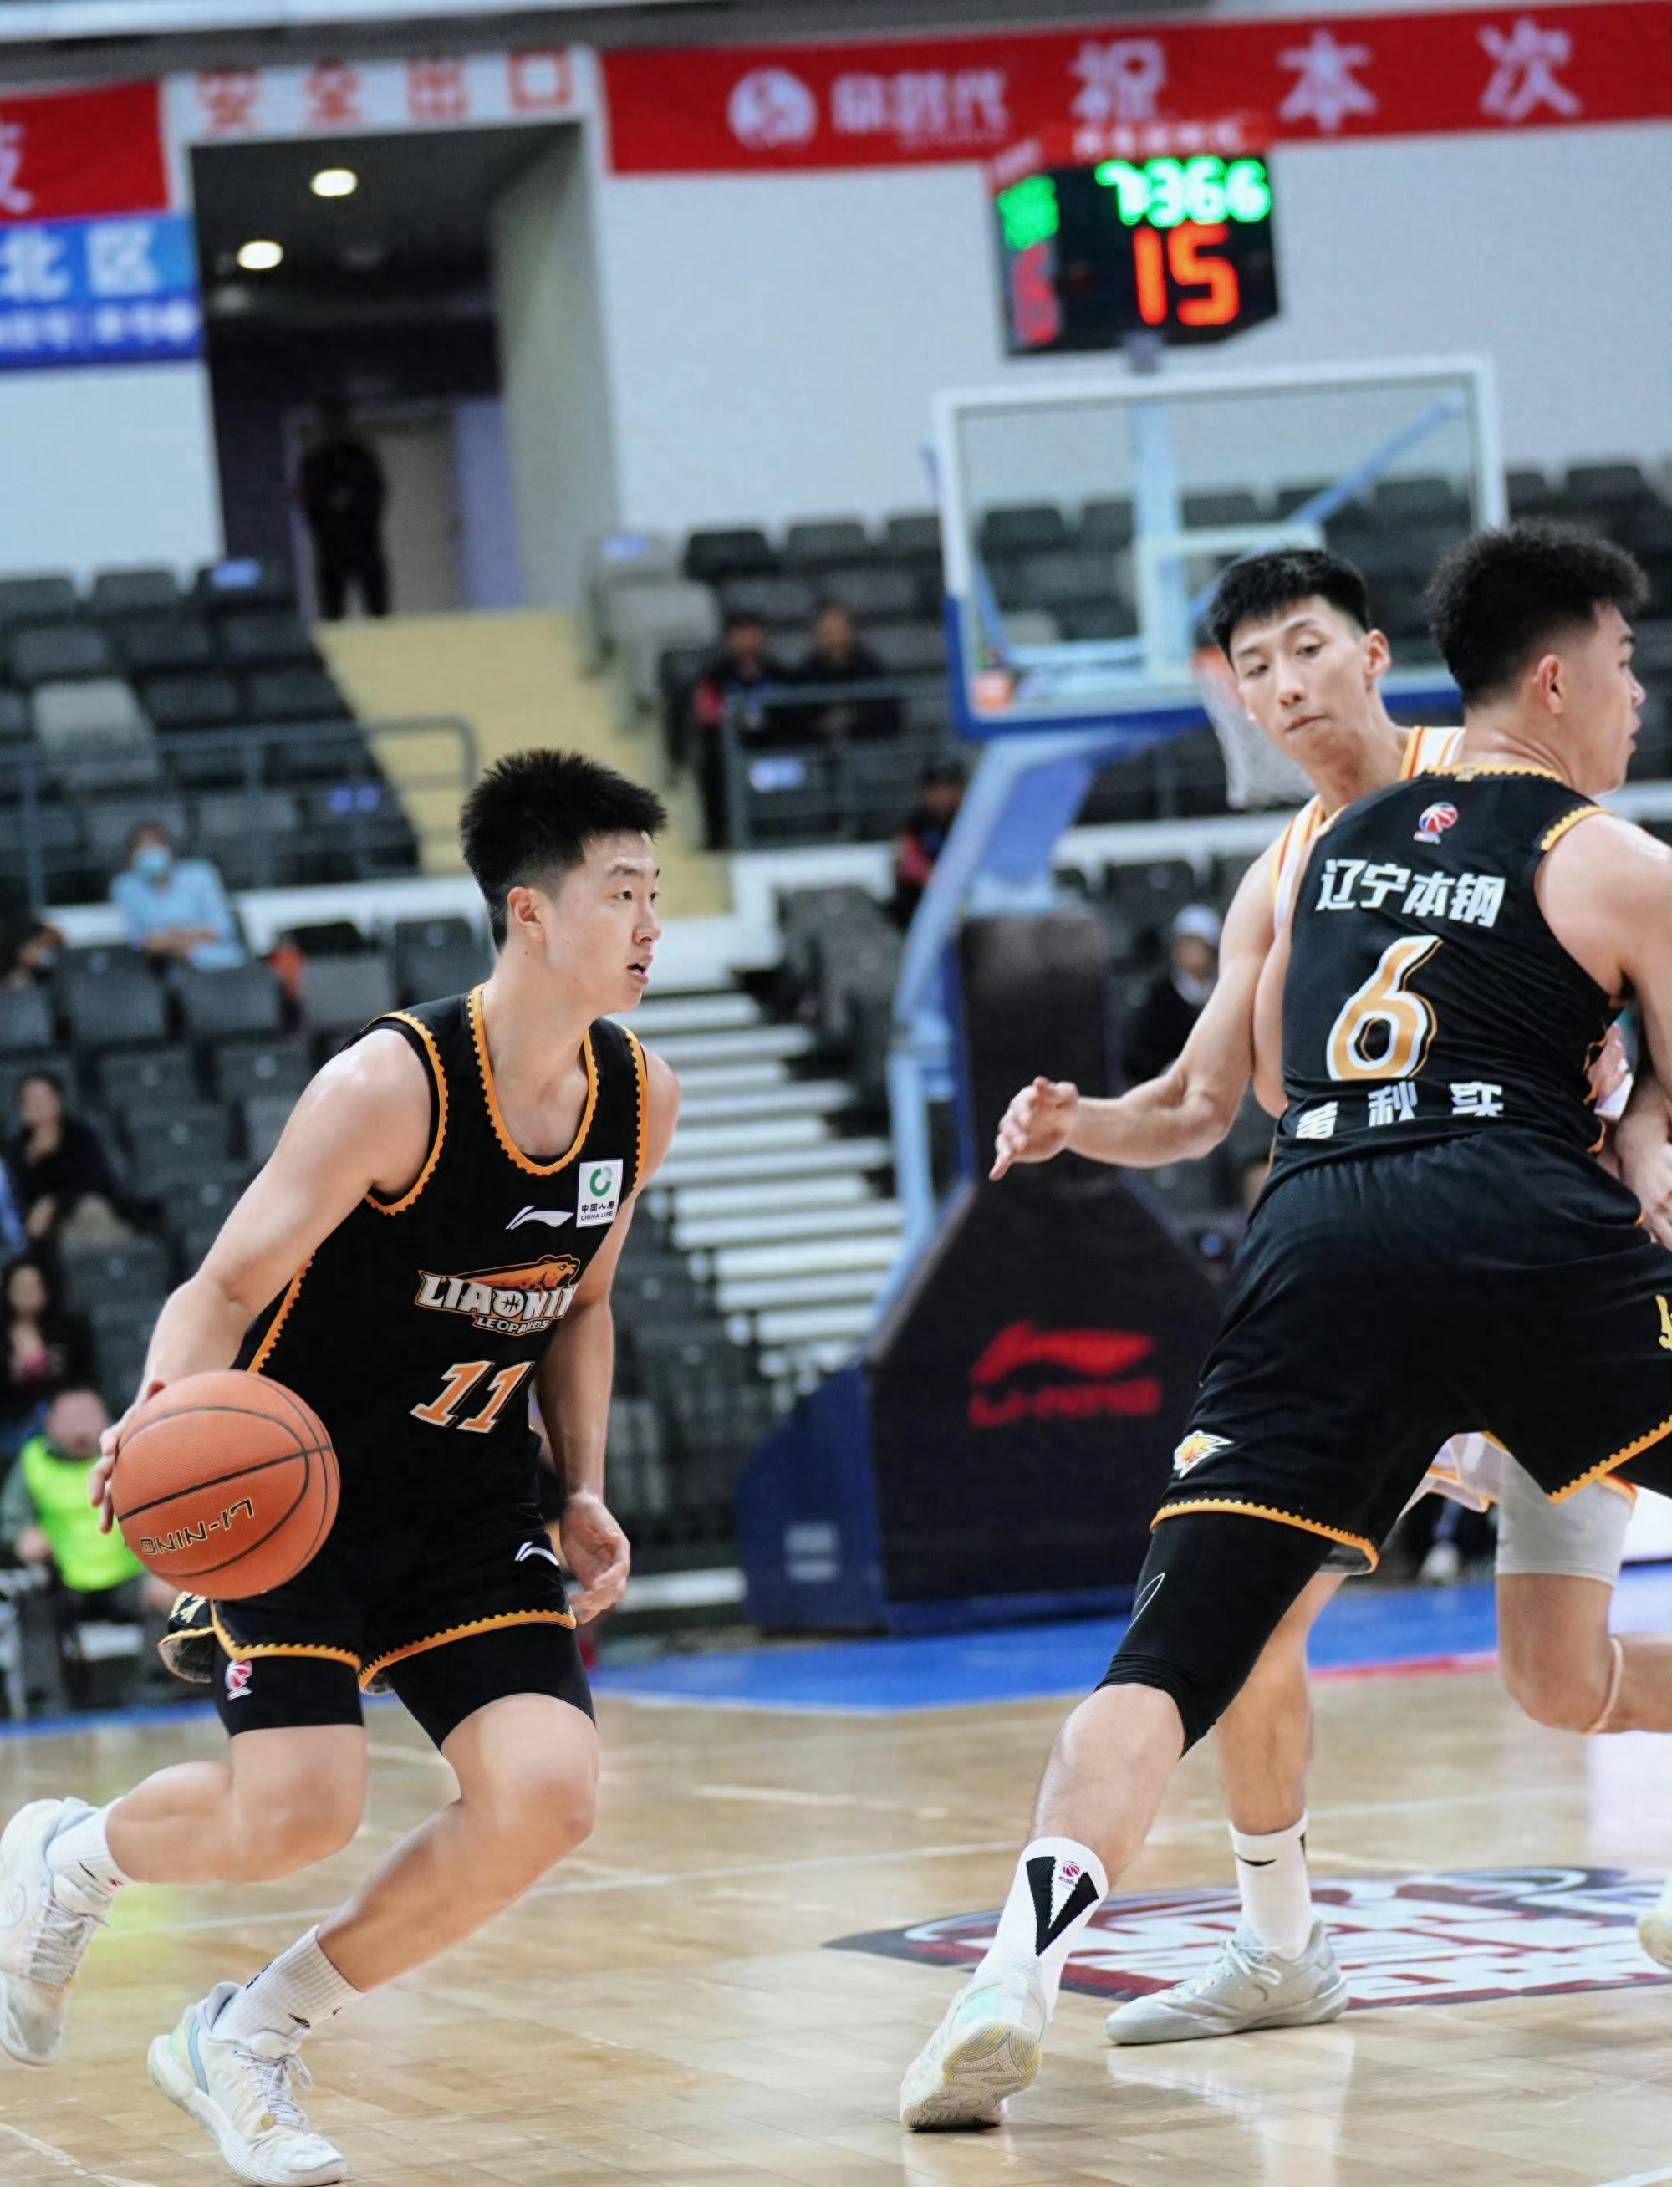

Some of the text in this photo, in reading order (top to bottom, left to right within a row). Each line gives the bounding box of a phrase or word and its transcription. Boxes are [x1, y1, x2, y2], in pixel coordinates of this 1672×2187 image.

[198, 48, 572, 132] 安全出口
[1069, 18, 1581, 132] 祝本次
[1133, 221, 1240, 326] 15
[1315, 858, 1506, 928] 辽宁本钢
[1326, 935, 1443, 1081] 6
[410, 1360, 534, 1433] 11
[139, 1497, 254, 1556] LI-NING
